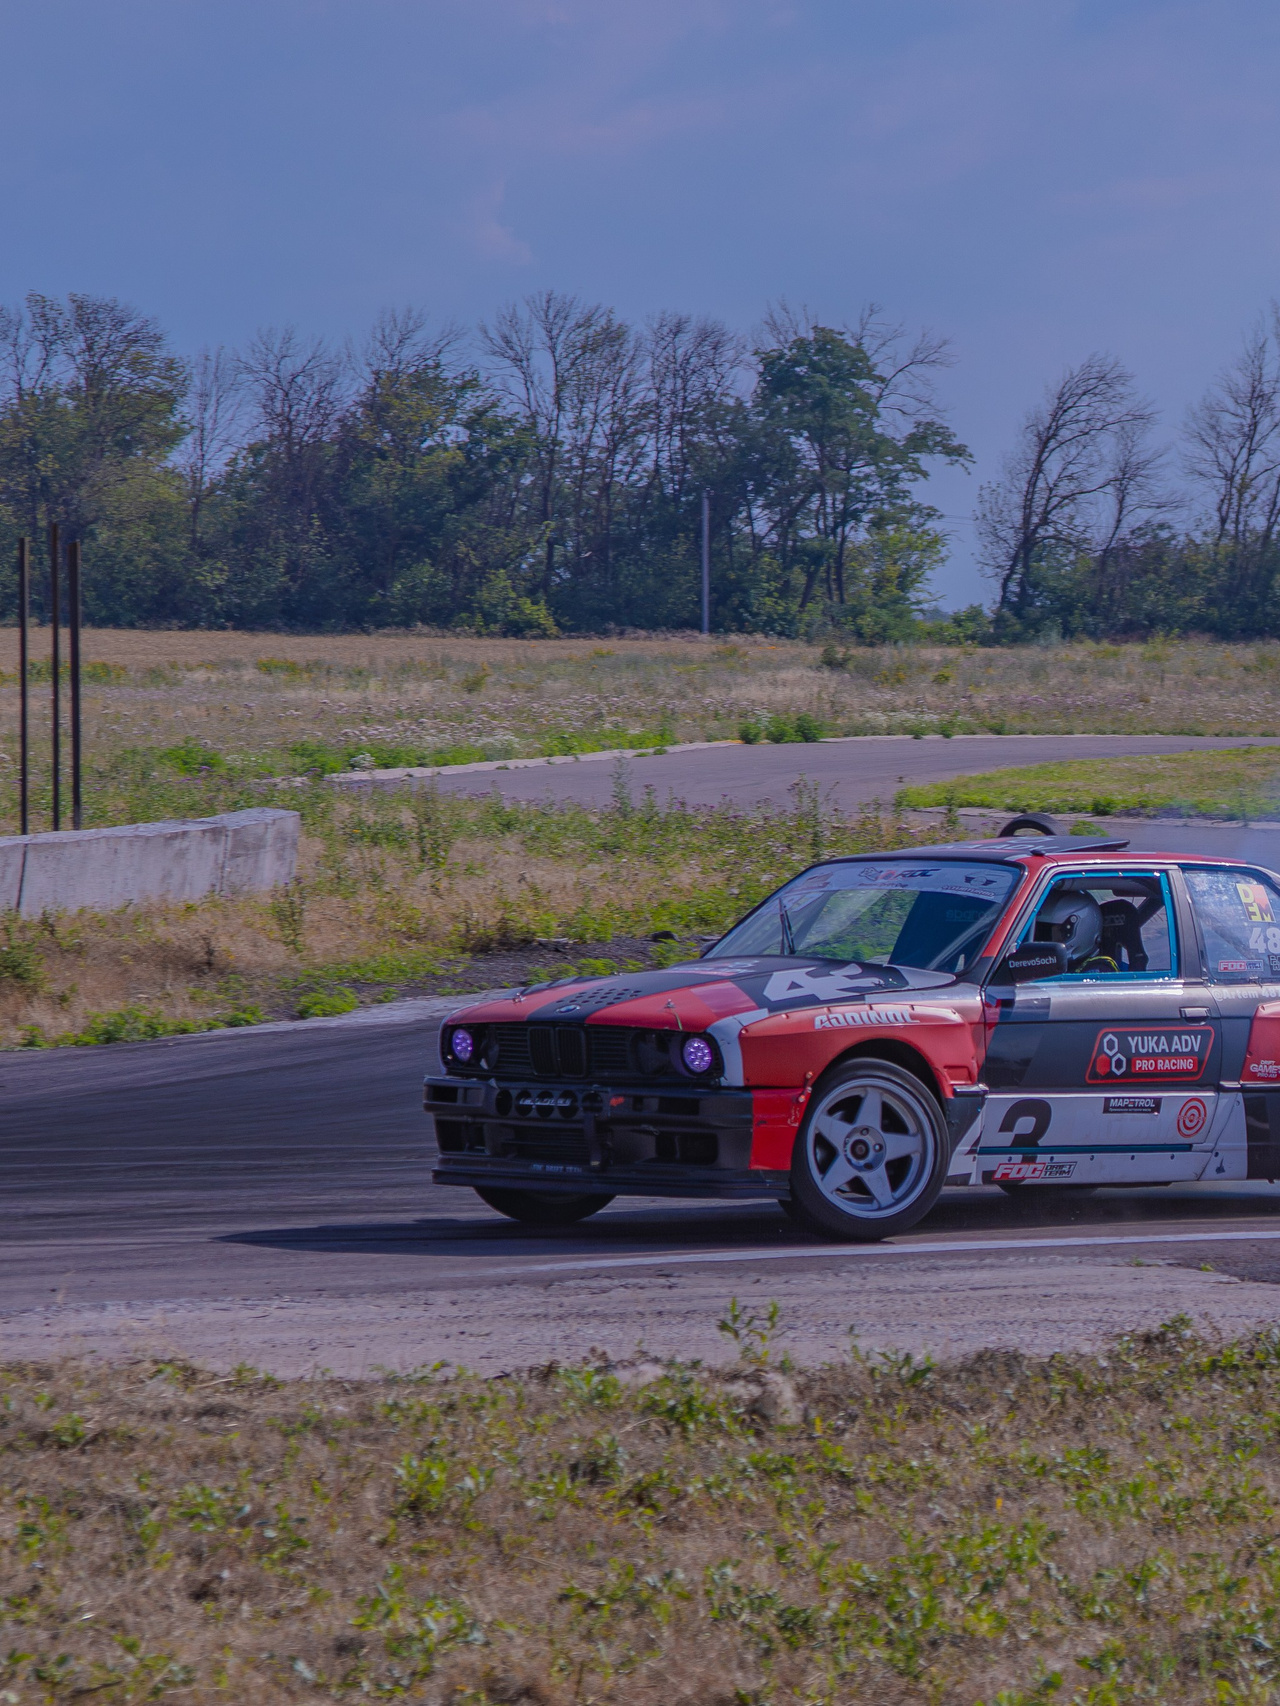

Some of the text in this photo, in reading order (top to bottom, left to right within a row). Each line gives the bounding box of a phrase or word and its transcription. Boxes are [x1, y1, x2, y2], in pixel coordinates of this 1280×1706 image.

[1008, 956, 1057, 968] DerevoSochi
[1213, 988, 1260, 1001] @Artem
[814, 1009, 920, 1030] ADDINOL
[1127, 1035, 1202, 1054] YUKA ADV
[1135, 1058, 1194, 1071] PRO RACING
[1109, 1098, 1156, 1108] MAPETROL
[1044, 1169, 1071, 1177] TEAM
